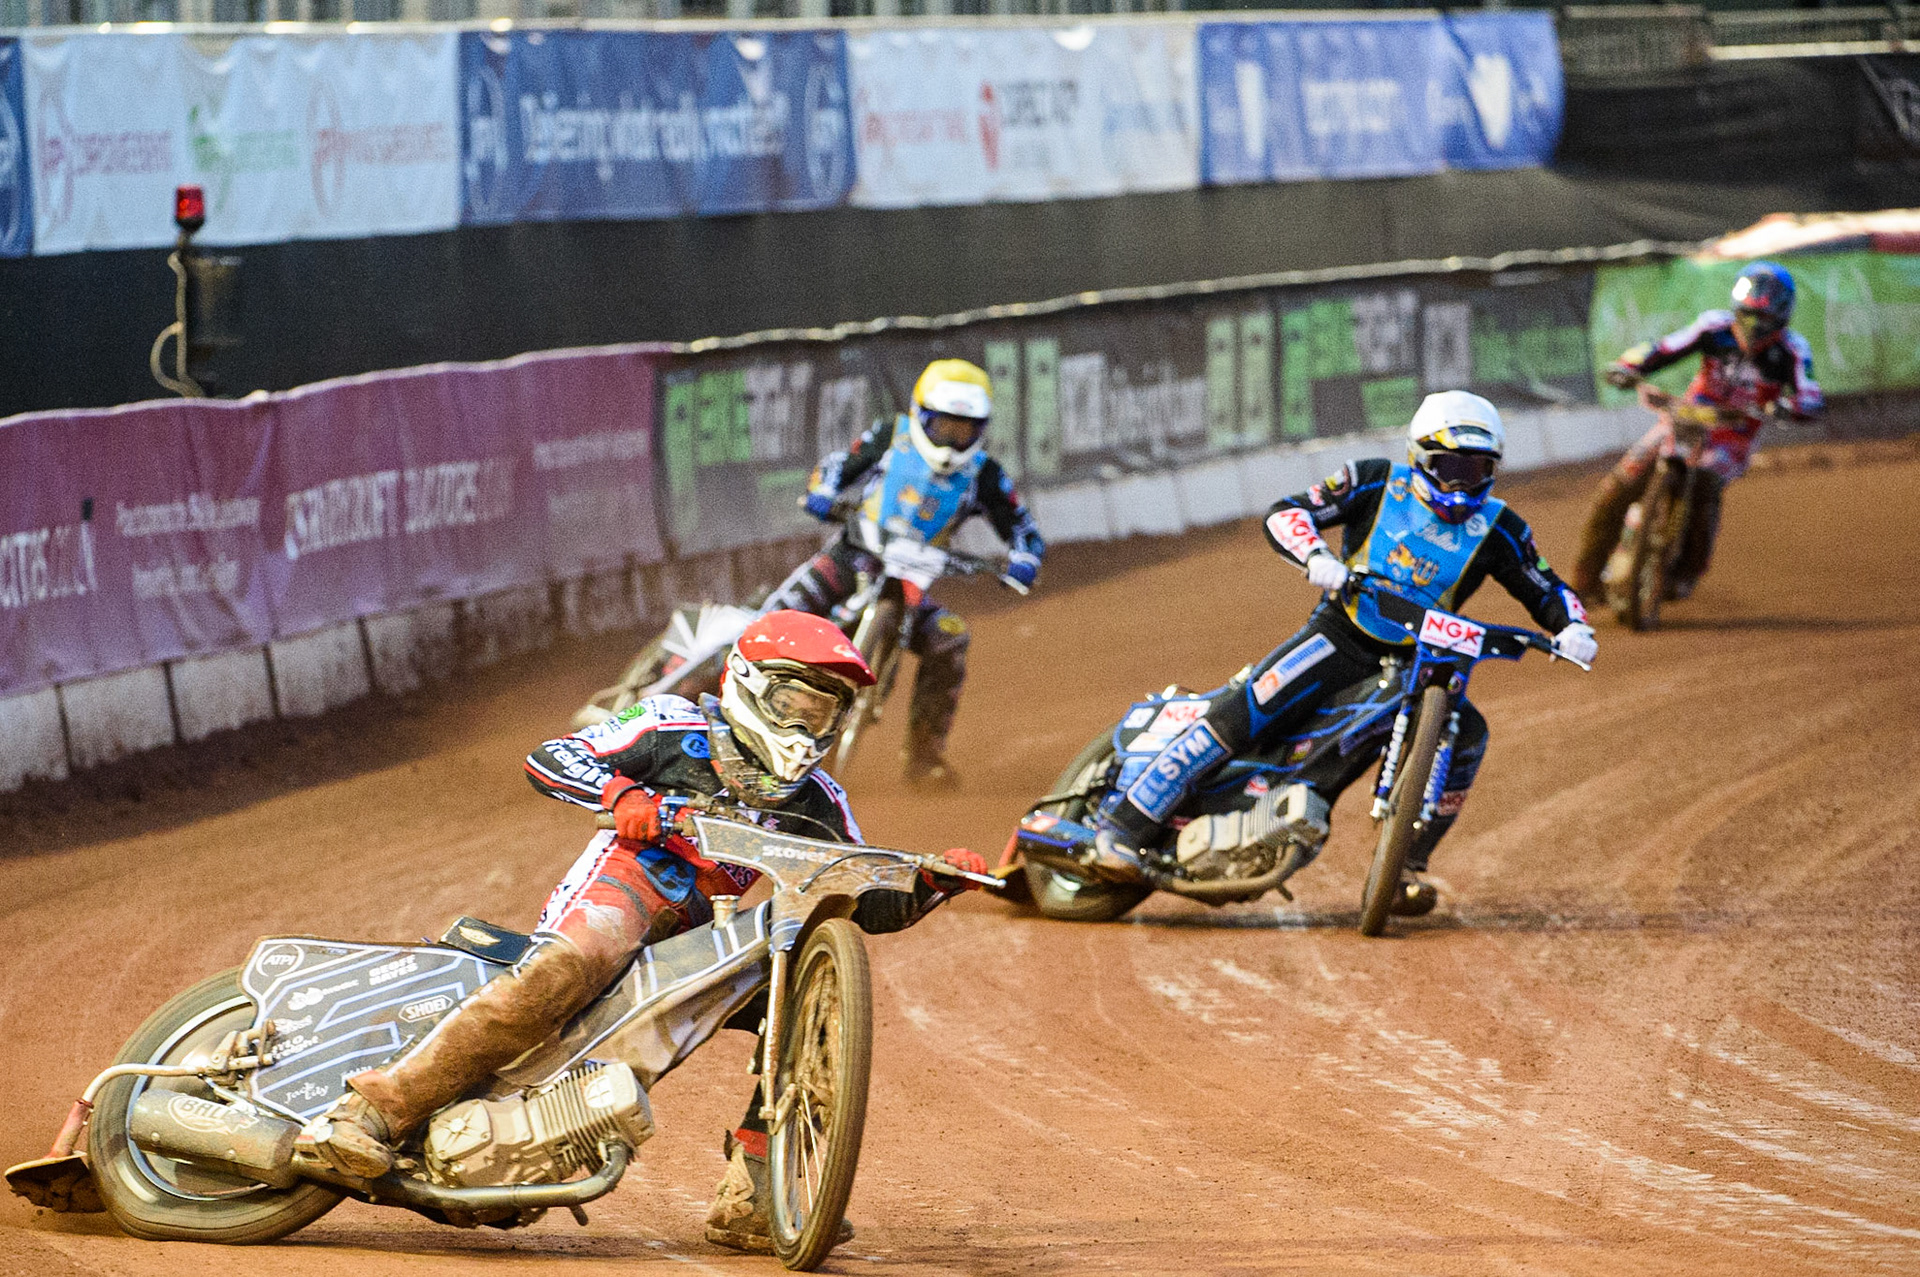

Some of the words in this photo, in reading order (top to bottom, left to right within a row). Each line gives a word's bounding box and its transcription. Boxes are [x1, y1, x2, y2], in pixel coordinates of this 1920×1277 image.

[1426, 615, 1483, 646] NGK
[262, 954, 298, 967] ATPI
[405, 998, 448, 1020] SHOEI
